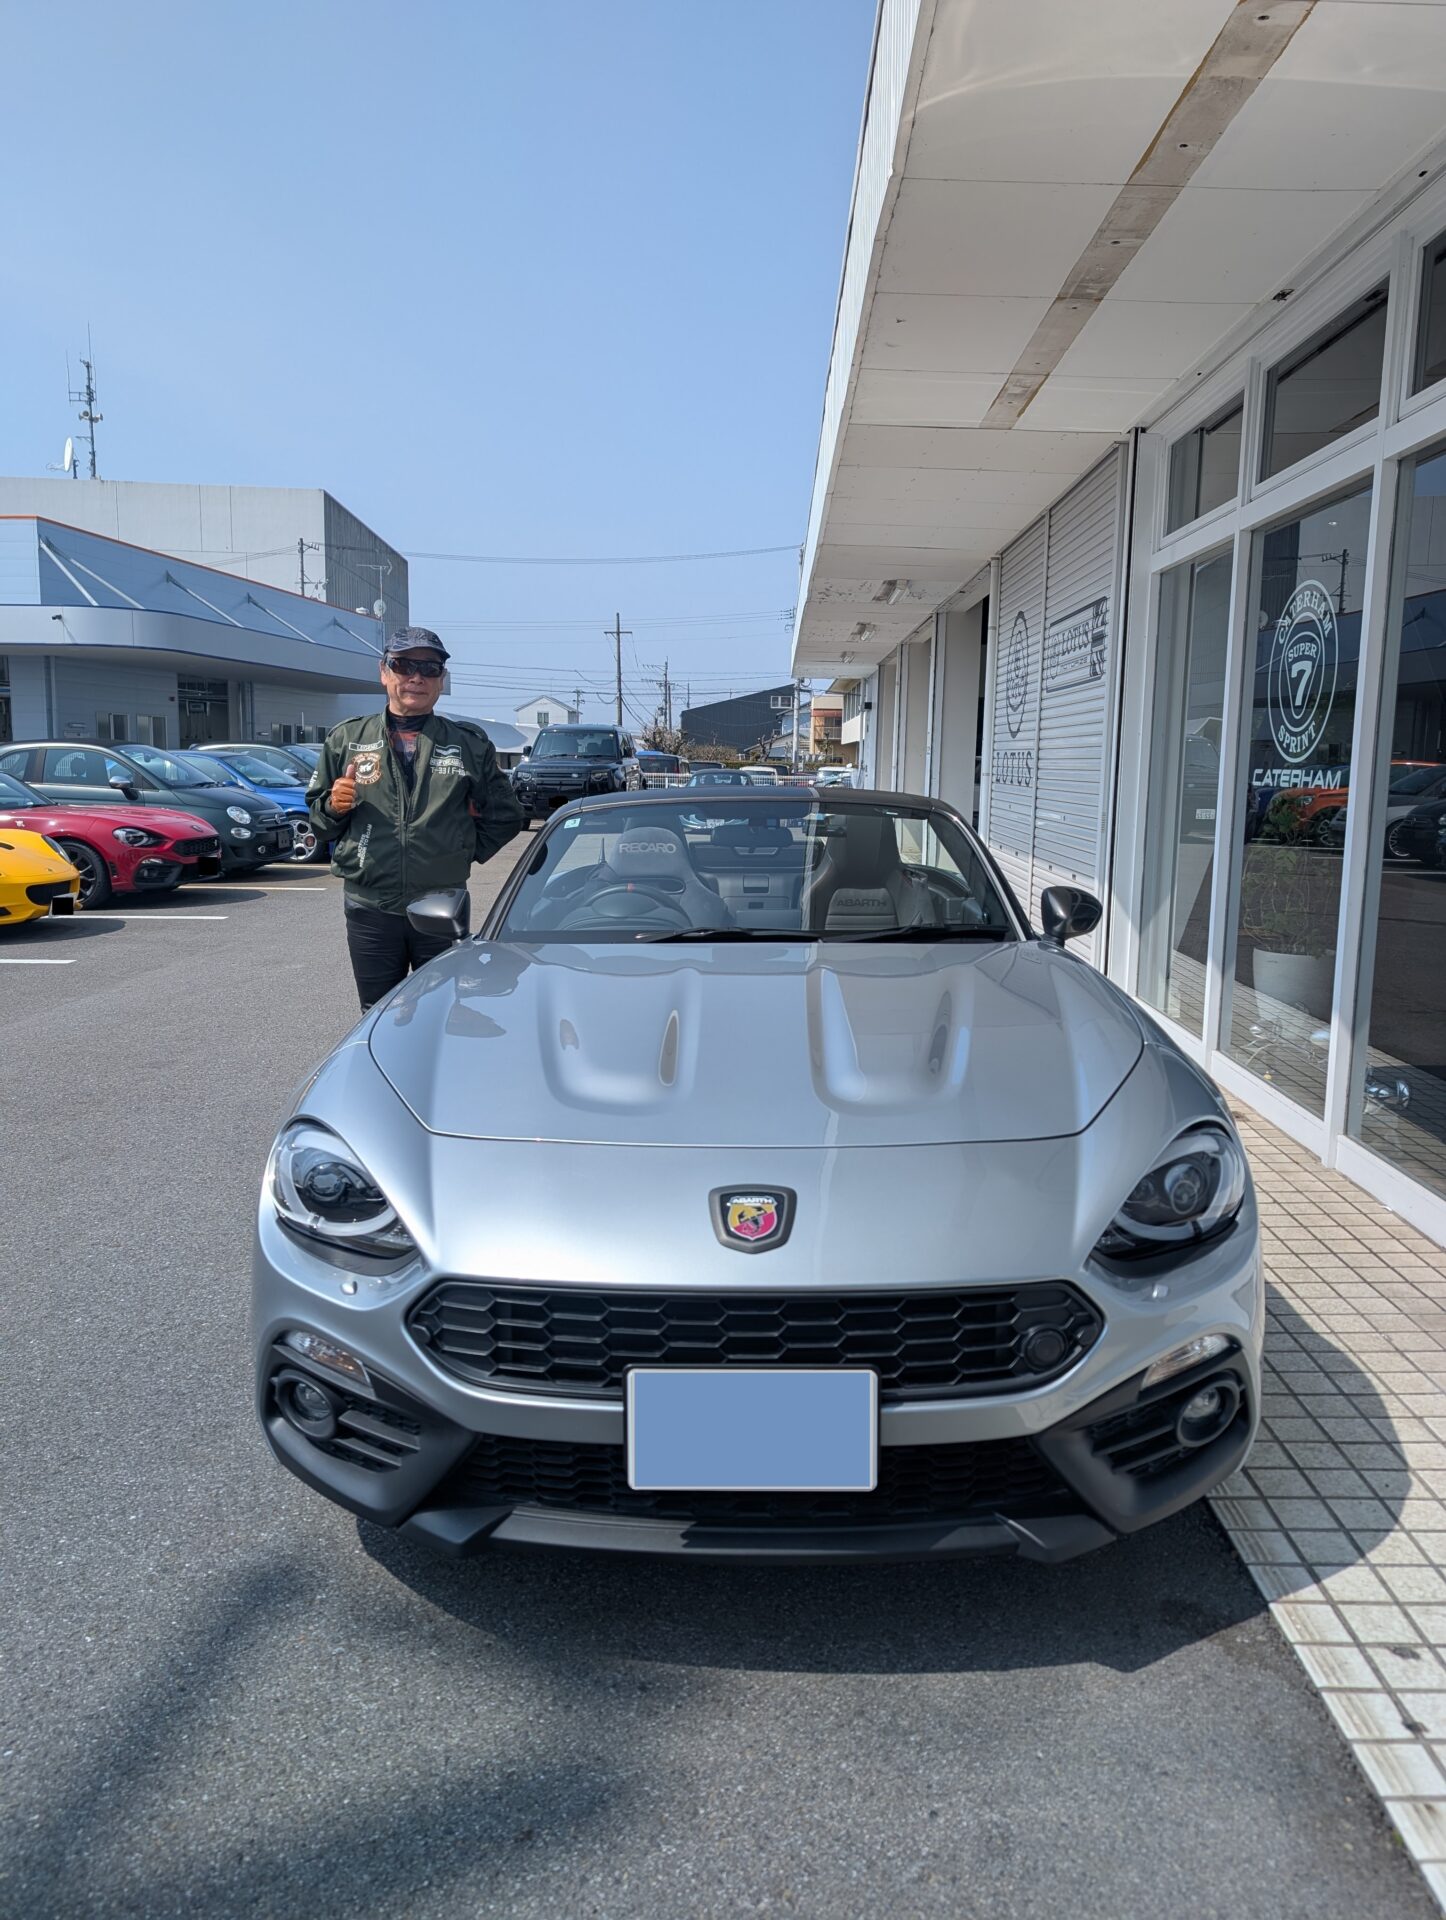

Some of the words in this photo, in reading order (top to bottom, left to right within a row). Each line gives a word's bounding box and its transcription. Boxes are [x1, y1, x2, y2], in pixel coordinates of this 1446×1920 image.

[1278, 590, 1333, 644] CATERHAM
[1062, 622, 1090, 656] LOTUS
[1288, 642, 1317, 662] SUPER
[1291, 660, 1313, 706] 7
[1278, 721, 1316, 753] SPRINT
[996, 751, 1033, 787] LOTUS
[1252, 768, 1342, 790] CATERHAM
[619, 842, 677, 854] RECARO
[837, 898, 887, 907] ABARTH
